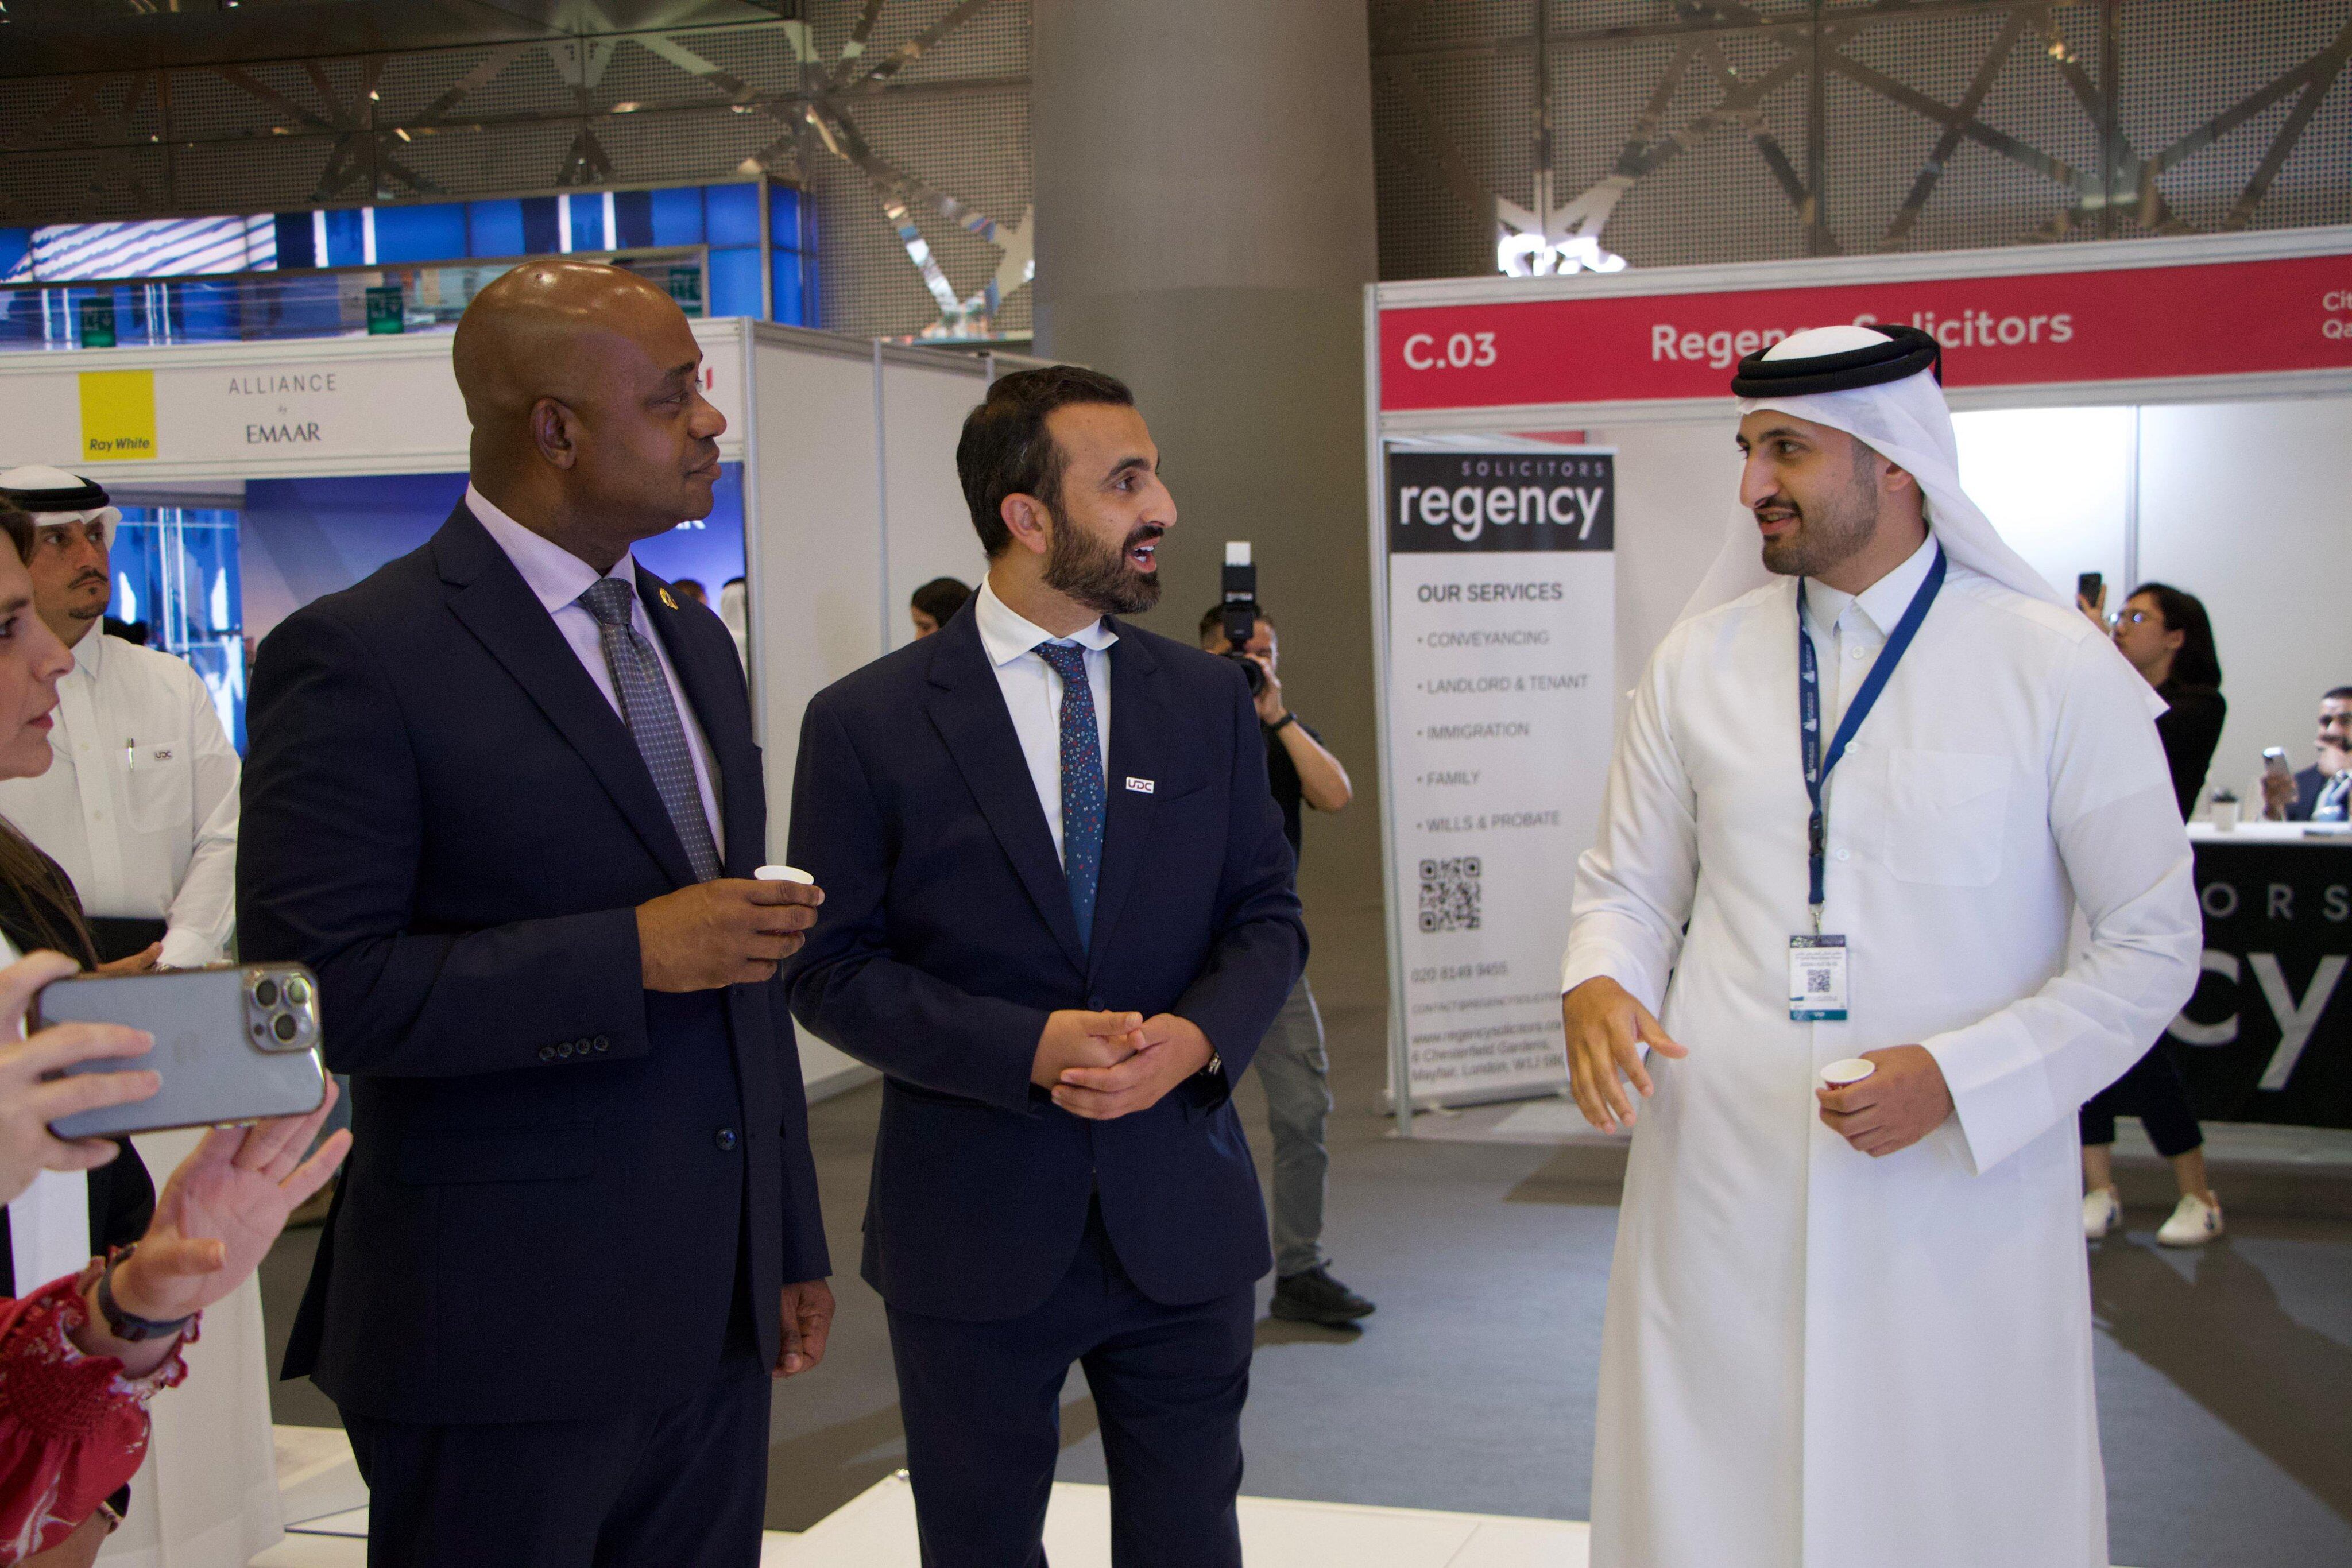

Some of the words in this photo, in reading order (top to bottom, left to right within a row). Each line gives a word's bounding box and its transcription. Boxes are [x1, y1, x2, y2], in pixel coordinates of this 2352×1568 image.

[1403, 332, 1496, 370] C.03
[1651, 323, 1810, 369] Regen
[230, 373, 336, 395] ALLIANCE
[247, 422, 322, 444] EMAAR
[90, 438, 112, 452] Ray
[115, 437, 150, 450] White
[1461, 461, 1604, 477] SOLICITORS
[1400, 486, 1603, 541] regency
[1417, 583, 1460, 602] OUR
[1467, 582, 1563, 602] SERVICES
[1426, 630, 1549, 648] CONVEYANCING
[1426, 676, 1511, 695] LANDLORD
[1515, 676, 1525, 692] &
[1530, 673, 1589, 691] TENANT
[1426, 722, 1530, 740] IMMIGRATION
[156, 750, 172, 759] UDC
[1128, 779, 1152, 792] UDC
[1426, 769, 1480, 787] FAMILY
[1426, 815, 1473, 833] WILLS
[1477, 815, 1487, 831] &
[1491, 810, 1560, 829] PROBATE
[2202, 882, 2349, 920] ORS
